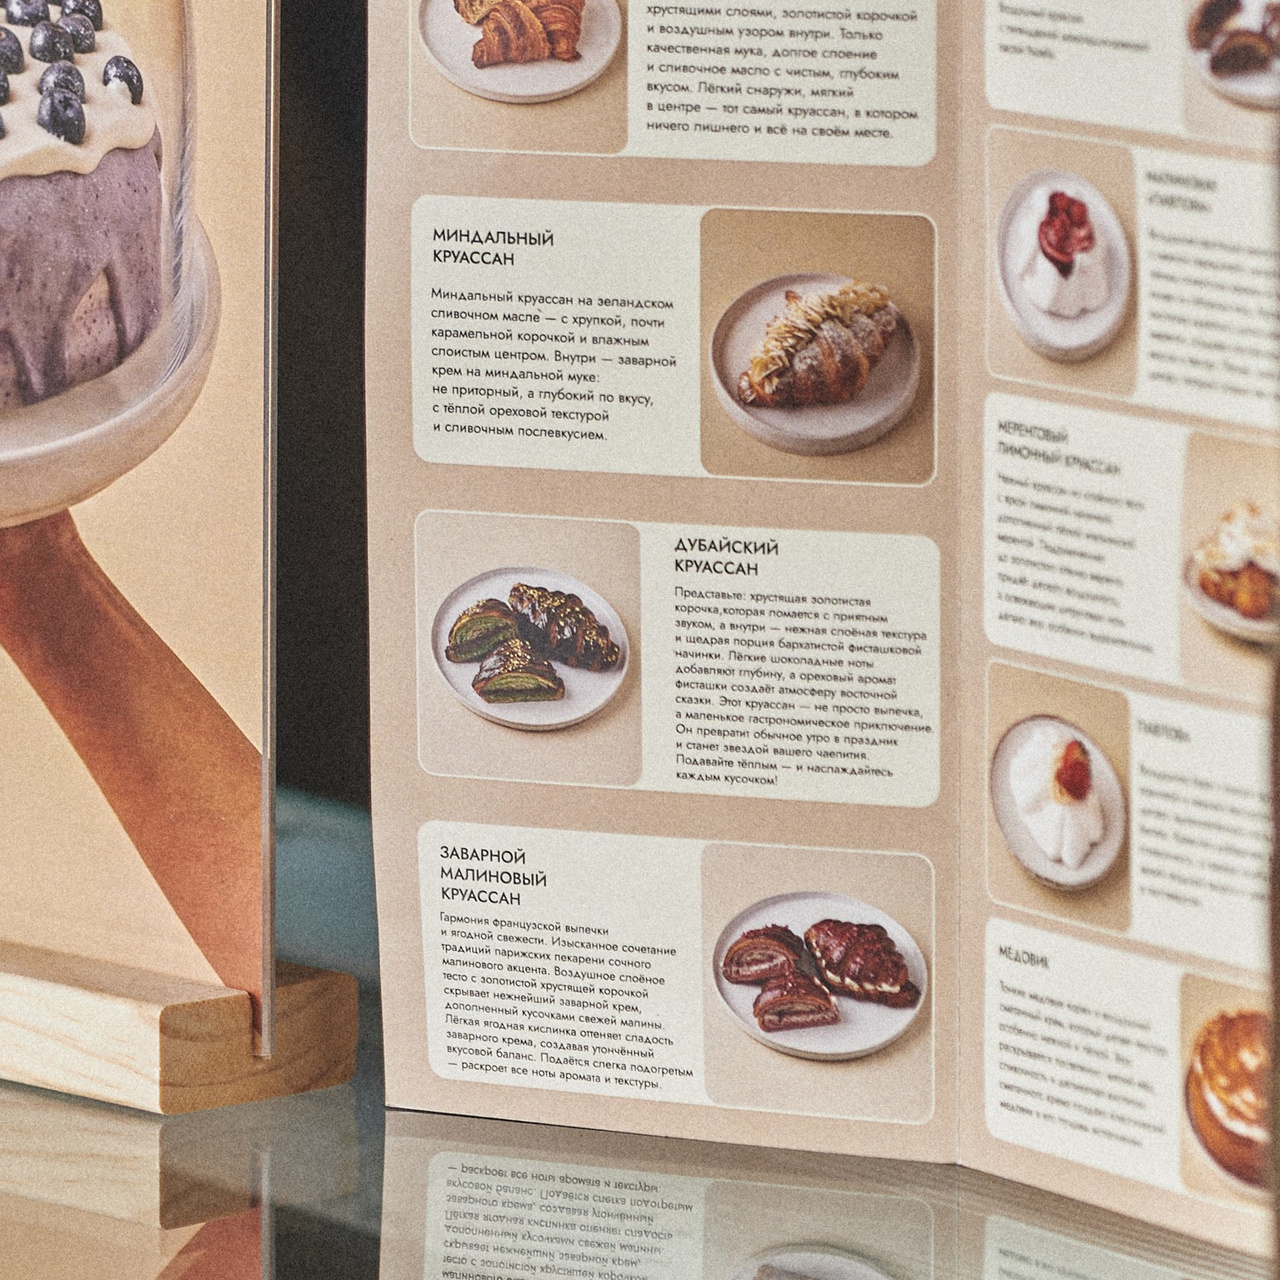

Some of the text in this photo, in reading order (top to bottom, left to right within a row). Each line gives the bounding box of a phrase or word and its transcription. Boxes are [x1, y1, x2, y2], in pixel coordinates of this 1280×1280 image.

[659, 25, 734, 37] воздушным
[738, 28, 784, 39] узором
[840, 27, 883, 40] Только
[646, 44, 730, 55] качественная
[772, 48, 818, 58] долгое
[822, 50, 877, 60] слоение
[698, 81, 742, 94] Лёгкий
[810, 86, 854, 97] мягкий
[646, 122, 690, 132] ничего
[694, 123, 750, 134] лишнего
[766, 124, 788, 135] всё
[792, 127, 807, 136] на
[811, 126, 850, 137] своём
[433, 228, 554, 246] МИНДАЛЬНЫЙ
[433, 249, 514, 266] КРУАССАН
[431, 288, 674, 309] Миндальный круассан на зеландском
[431, 309, 664, 328] сливочном масле с хрупкой, почти
[431, 328, 512, 340] карамельной
[517, 332, 575, 344] корочкой
[592, 336, 649, 346] влажным
[431, 347, 676, 368] слоистым центром. Внутри заварной
[432, 367, 598, 384] крем на миндальной муке:
[432, 386, 653, 407] не приторный, а глубокий по вкусу,
[432, 403, 609, 423] с тёплой ореховой текстурой
[444, 424, 514, 435] сливочным
[518, 428, 606, 441] послевкусием.
[674, 537, 779, 556] ДУБАЙСКИЙ
[674, 558, 758, 576] КРУАССАН
[750, 593, 807, 604] хрустящая
[811, 596, 871, 606] золотистая
[728, 650, 766, 663] Лёгкие
[770, 656, 844, 667] шоколадные
[847, 660, 874, 668] ноты
[676, 753, 734, 768] Подавайте
[737, 759, 778, 770] тёплым
[806, 765, 893, 777] наслаждайтесь
[676, 772, 778, 785] каждым кусочком!
[440, 845, 526, 864] ЗАВАРНОЙ
[440, 866, 546, 887] МАЛИНОВЫЙ
[441, 887, 520, 905] КРУАССАН
[440, 911, 608, 935] Гармония французской выпечки
[451, 930, 493, 940] ягодной
[497, 934, 546, 944] свежести.
[552, 936, 618, 951] Изысканное
[622, 944, 676, 956] сочетание
[441, 943, 491, 954] традиций
[494, 948, 550, 960] парижских
[608, 958, 651, 969] сочного
[442, 958, 665, 985] малинового акцента. Воздушное слоёное
[443, 972, 467, 982] тесто
[481, 976, 537, 988] золотистой
[540, 982, 595, 993] хрустящей
[599, 988, 648, 998] корочкой
[443, 987, 641, 1014] скрывает нежнейший заварной крем,
[445, 1002, 665, 1029] дополненный кусочками свежей малины.
[445, 1013, 673, 1045] Лёгкая ягодная кислинка оттеняет сладость
[447, 1031, 654, 1058] заварного крема, создавая утончённый
[446, 1045, 693, 1076] вкусовой баланс. Подаётся слегка подогретым
[461, 1062, 507, 1073] раскроет
[511, 1067, 528, 1075] все
[532, 1069, 556, 1078] ноты
[559, 1071, 600, 1082] аромата
[614, 1077, 662, 1089] текстуры.
